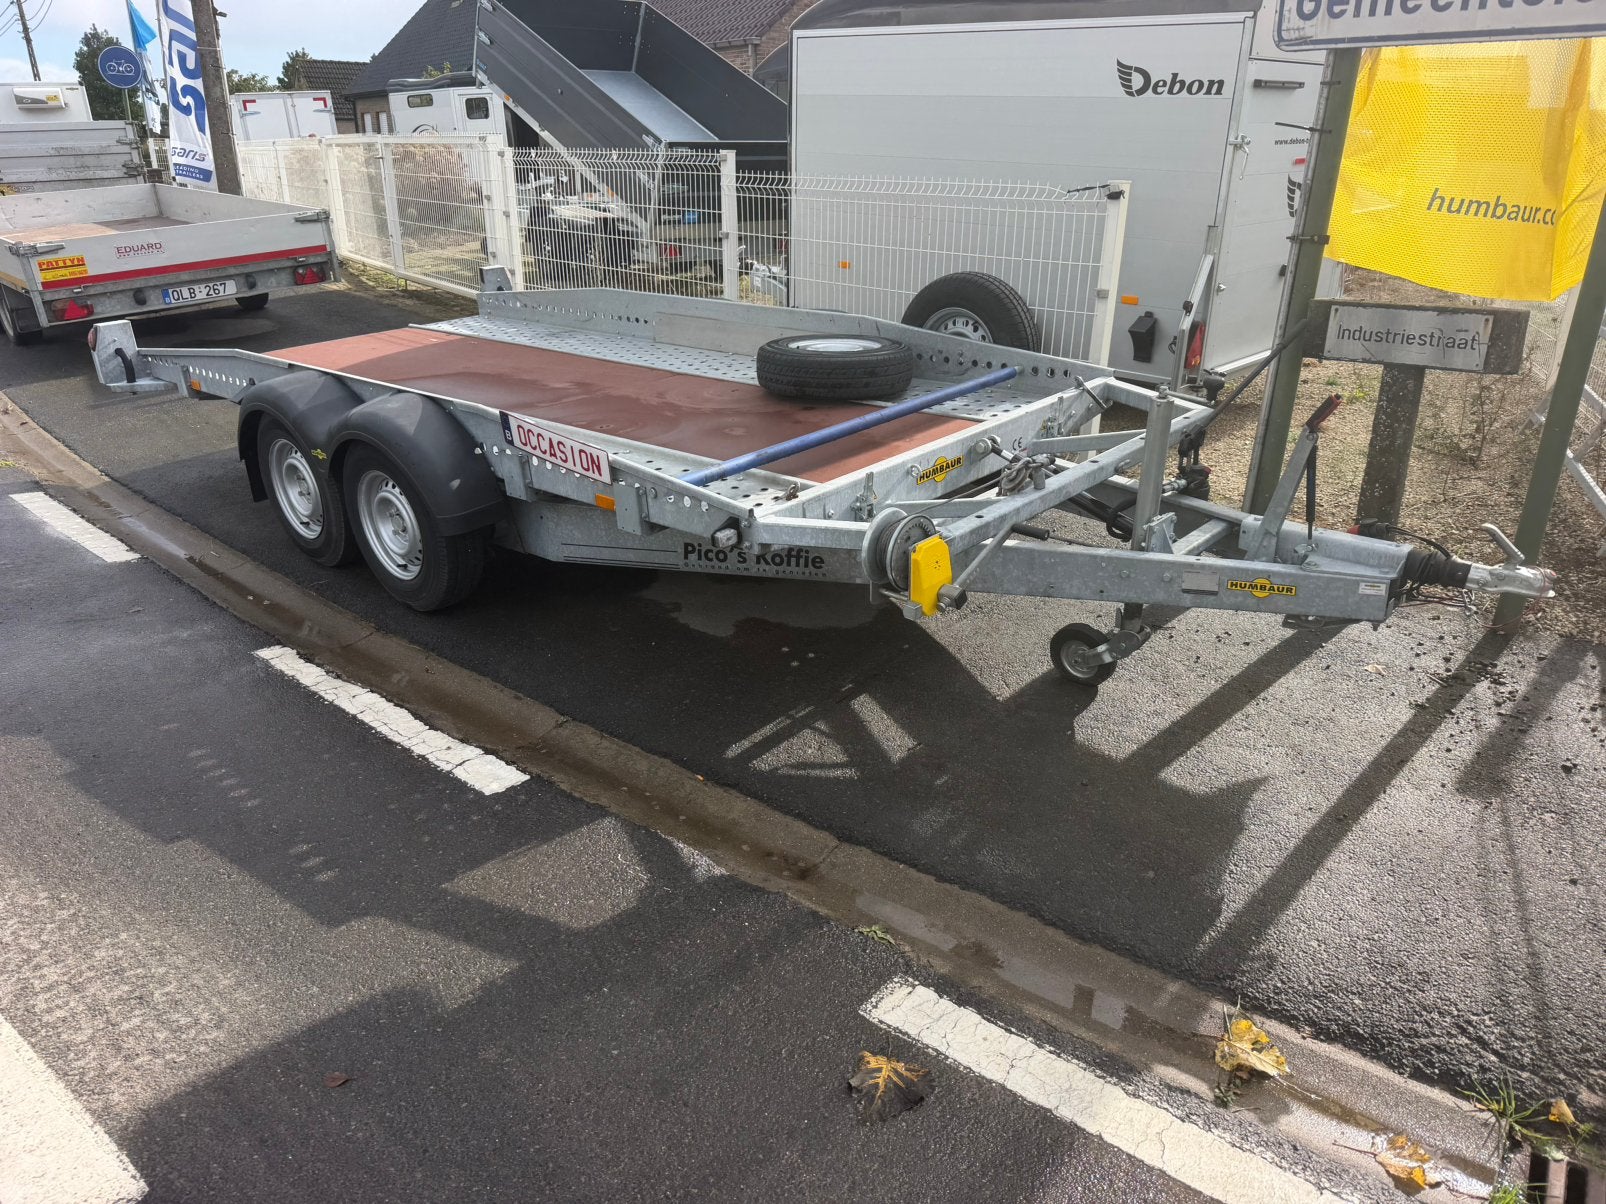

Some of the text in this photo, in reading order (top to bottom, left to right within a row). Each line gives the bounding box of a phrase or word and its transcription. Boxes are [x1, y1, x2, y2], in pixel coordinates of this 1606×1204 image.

[1116, 57, 1225, 98] Debon
[116, 242, 162, 254] EDUARD
[38, 256, 86, 269] PATTYN
[1336, 323, 1478, 351] Industriestraat
[504, 429, 512, 441] B
[516, 424, 603, 477] OCCASION
[918, 456, 963, 483] HUMBAUR
[755, 547, 826, 570] Koffie
[1228, 580, 1295, 595] HUMBAUR
